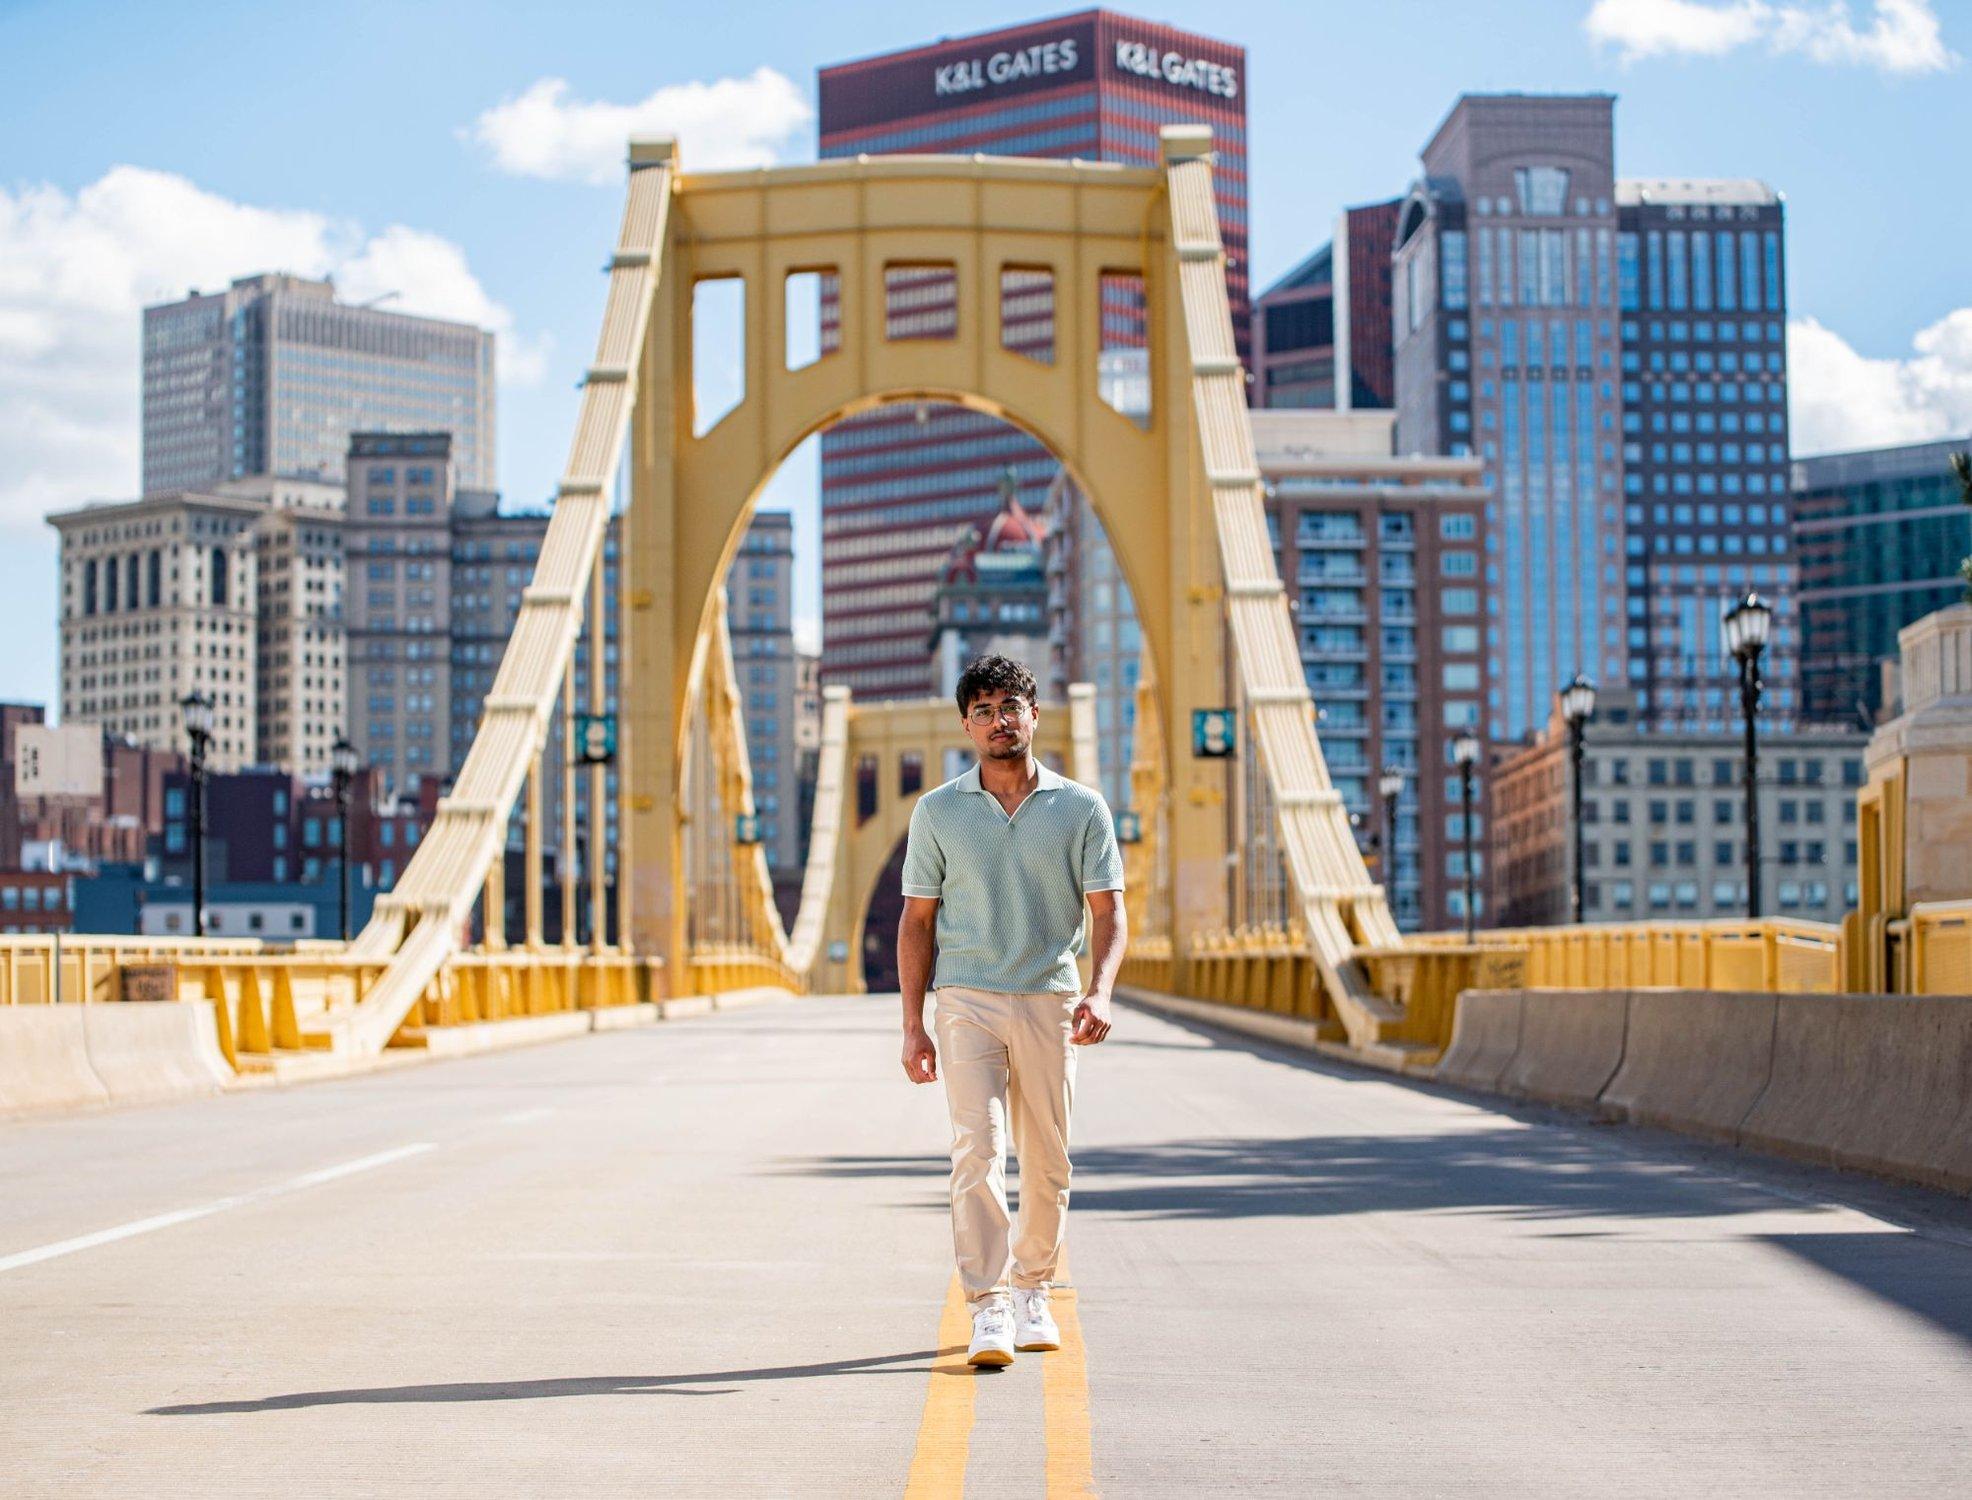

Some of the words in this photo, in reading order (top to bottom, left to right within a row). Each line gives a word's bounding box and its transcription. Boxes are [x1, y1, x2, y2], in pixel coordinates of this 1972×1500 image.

[935, 59, 986, 96] K&L
[987, 39, 1078, 84] GATES
[1116, 39, 1161, 79] K&L
[1162, 51, 1237, 98] GATES
